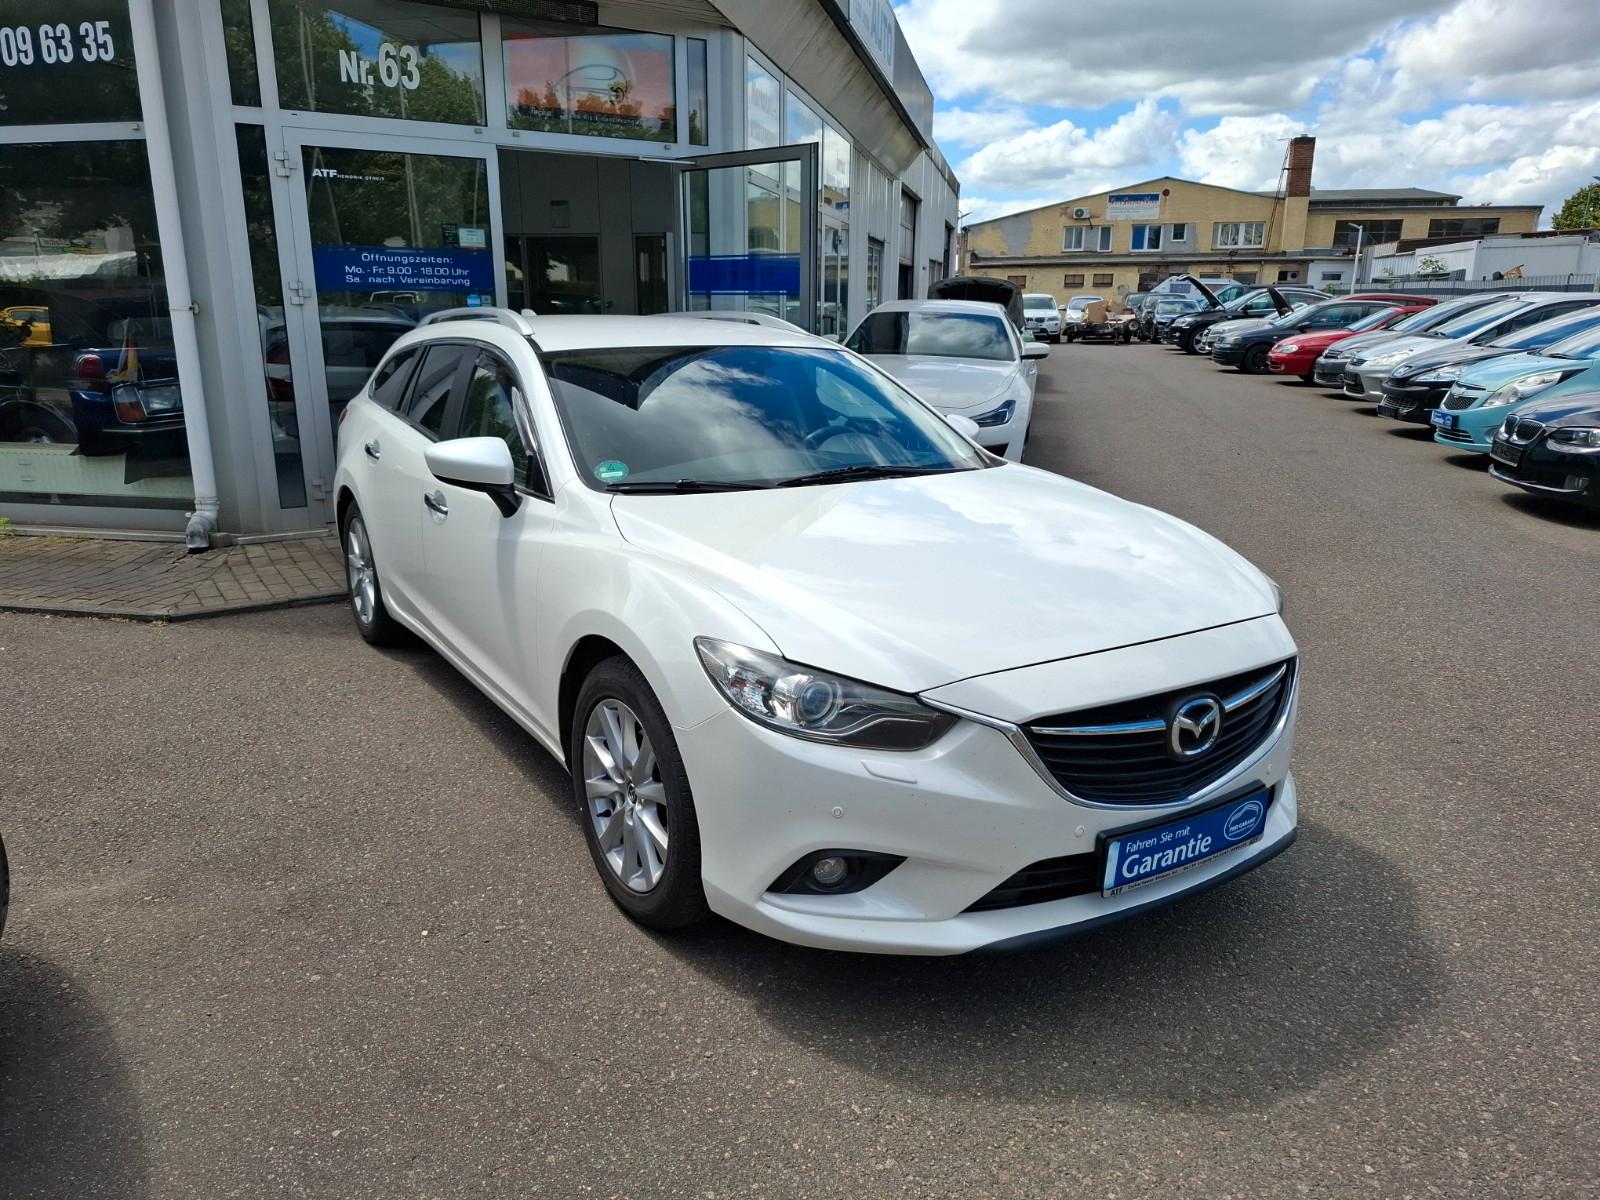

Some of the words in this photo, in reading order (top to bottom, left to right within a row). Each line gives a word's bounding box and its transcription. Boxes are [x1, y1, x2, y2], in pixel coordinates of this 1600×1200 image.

[0, 27, 34, 67] 09
[39, 24, 74, 64] 63
[80, 20, 115, 62] 35
[339, 49, 375, 86] Nr.
[378, 43, 420, 90] 63
[312, 168, 338, 177] ATF
[361, 252, 453, 264] Öffnungszeiten:
[345, 265, 365, 274] Mo.
[387, 266, 412, 275] 9.00
[420, 267, 450, 276] 18.00
[451, 268, 470, 276] Uhr
[345, 275, 362, 283] Sa.
[400, 276, 470, 287] Vereinbarung
[1126, 838, 1157, 854] Fahren
[1160, 831, 1174, 843] Sie
[1175, 825, 1191, 839] mit
[1122, 833, 1212, 878] Garantie
